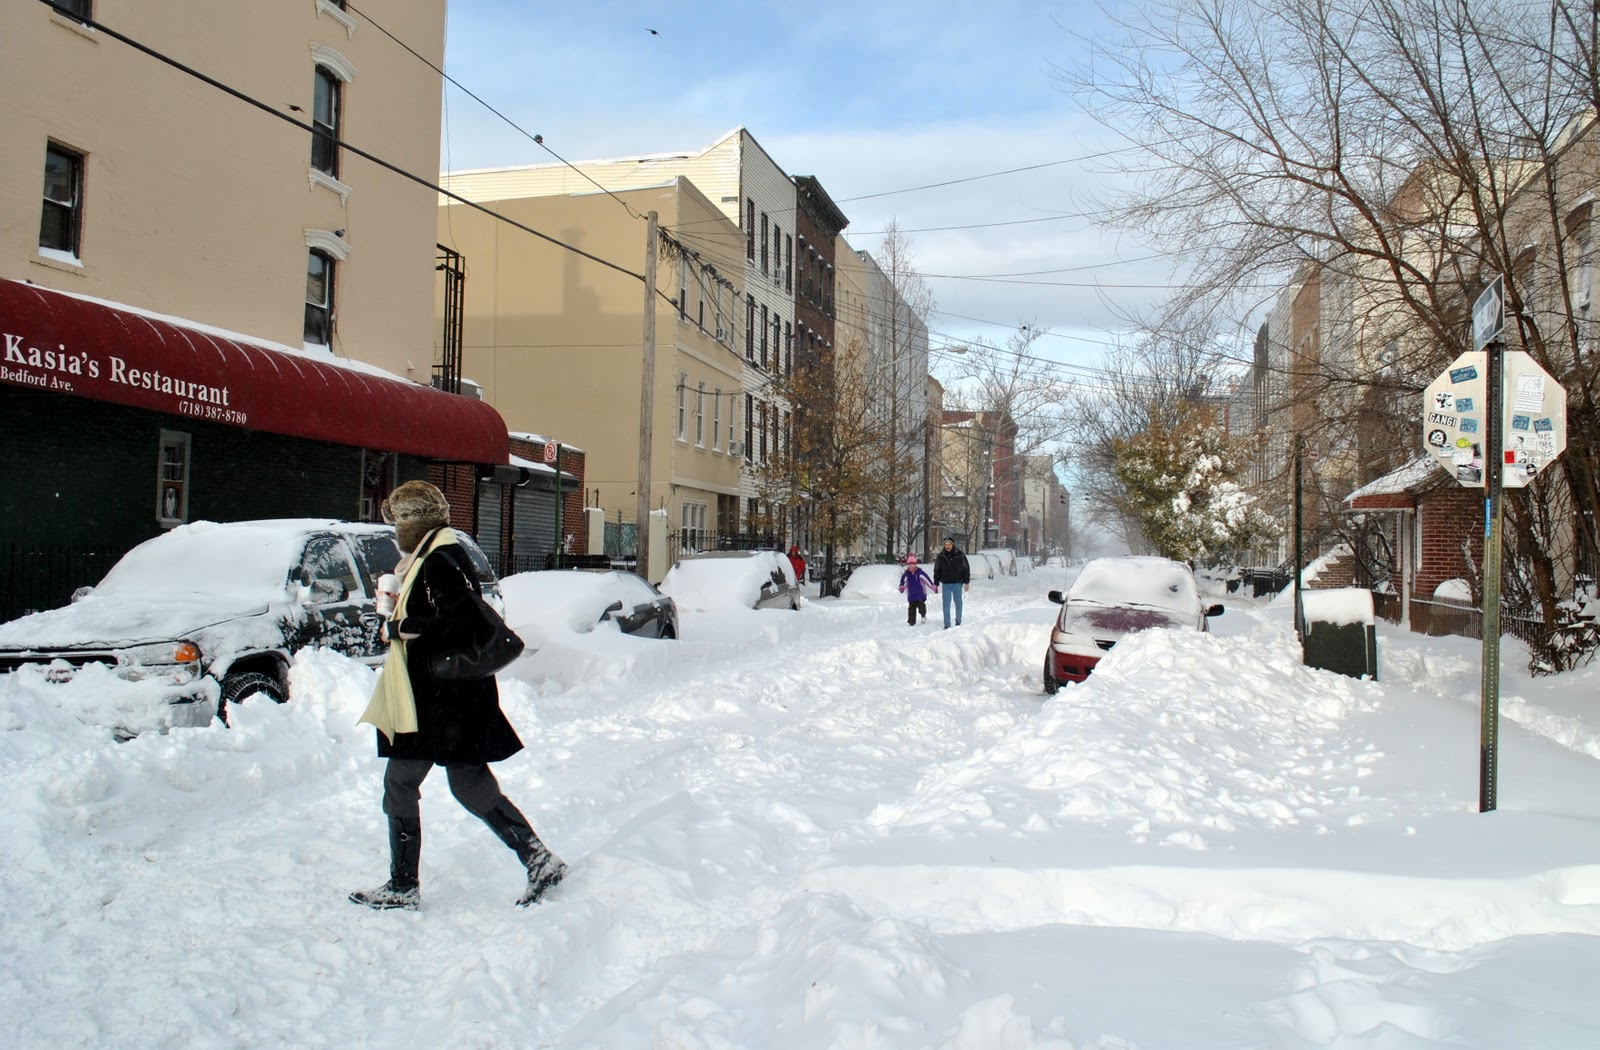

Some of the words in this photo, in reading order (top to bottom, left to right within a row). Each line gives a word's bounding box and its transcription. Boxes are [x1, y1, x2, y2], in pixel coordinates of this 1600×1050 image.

[0, 366, 47, 387] Bedford
[50, 376, 74, 391] Ave.
[3, 333, 99, 378] Kasia's
[109, 356, 230, 406] Restaurant
[178, 400, 204, 417] (718)
[205, 406, 247, 425] 387-8780
